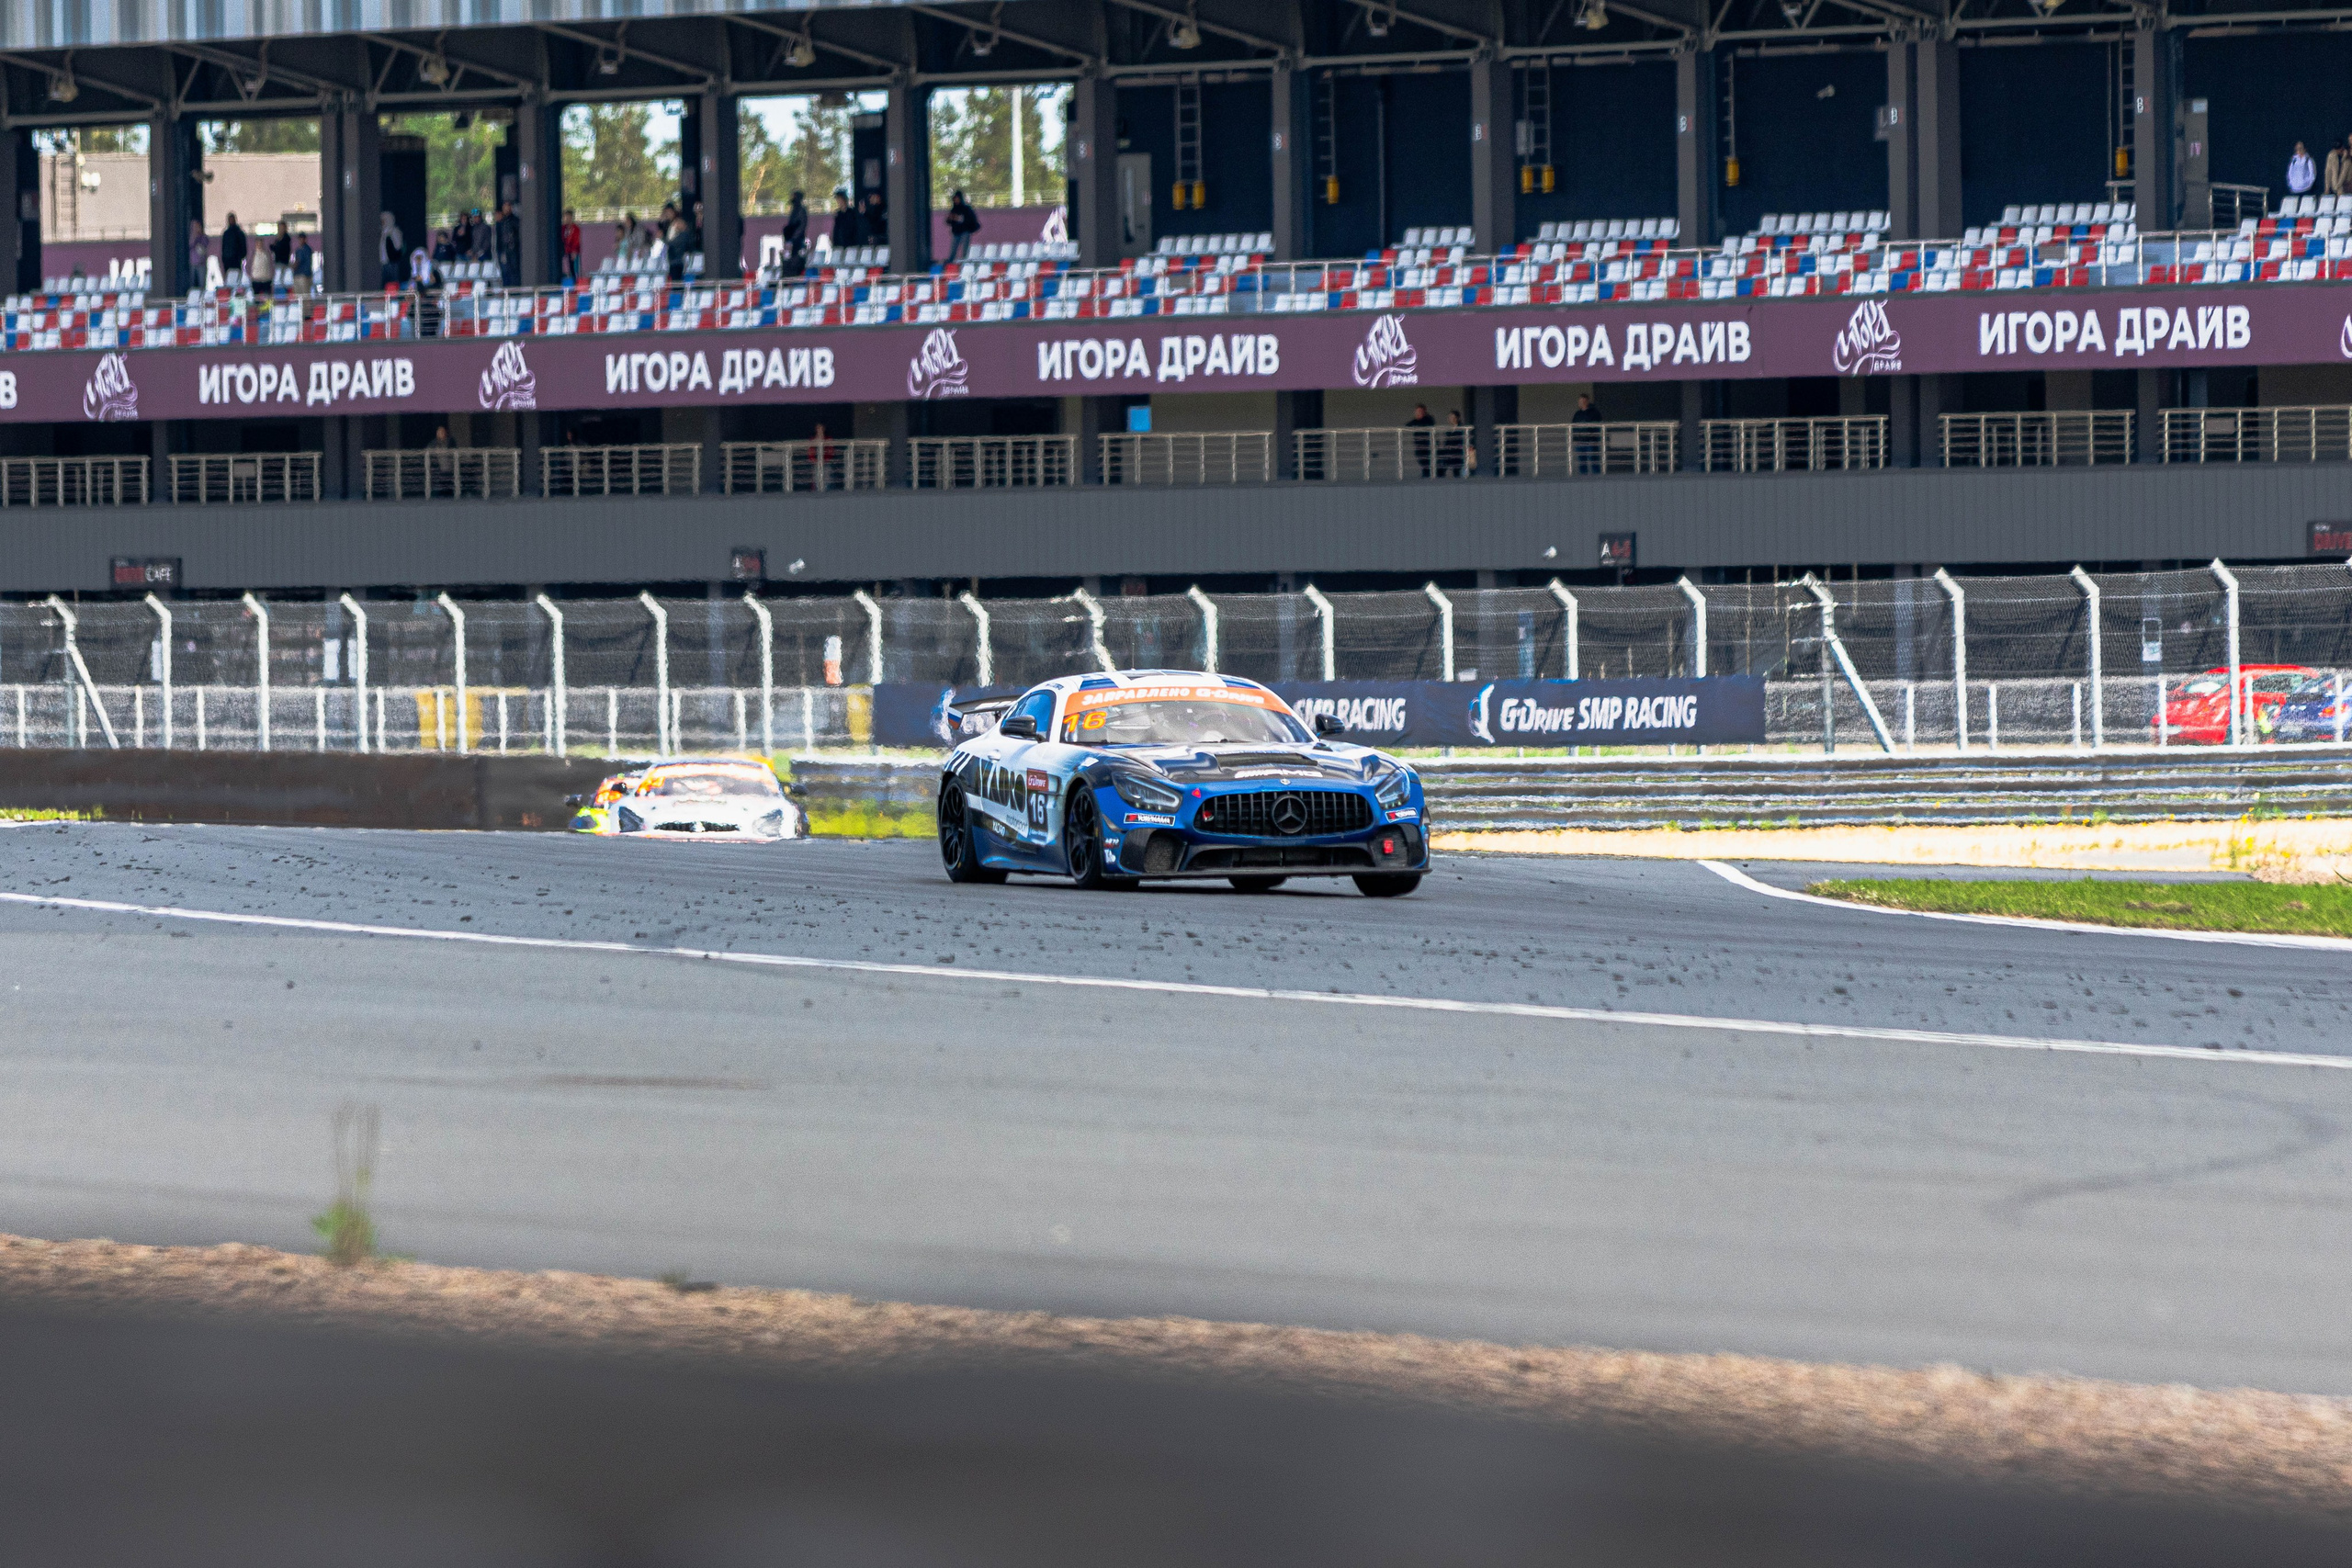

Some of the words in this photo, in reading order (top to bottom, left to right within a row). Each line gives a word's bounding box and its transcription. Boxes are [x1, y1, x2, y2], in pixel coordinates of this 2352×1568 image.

[1496, 325, 1614, 369] ИГОРА
[1623, 321, 1751, 371] ДРАЙВ
[1980, 310, 2106, 355] ИГОРА
[2115, 305, 2251, 356] ДРАЙВ
[605, 350, 713, 394] ИГОРА
[719, 347, 835, 396] ДРАЙВ
[1038, 338, 1151, 380] ИГОРА
[1158, 333, 1280, 383] ДРАЙВ
[199, 364, 300, 404] ИГОРА
[307, 358, 415, 406] ДРАЙВ
[1081, 688, 1191, 705] ЗАПРАВЛЕНО
[1338, 696, 1407, 731] RACING
[1577, 696, 1623, 730] SMP
[1623, 694, 1698, 730] RACING
[1063, 711, 1107, 733] 16
[1030, 793, 1046, 824] 16
